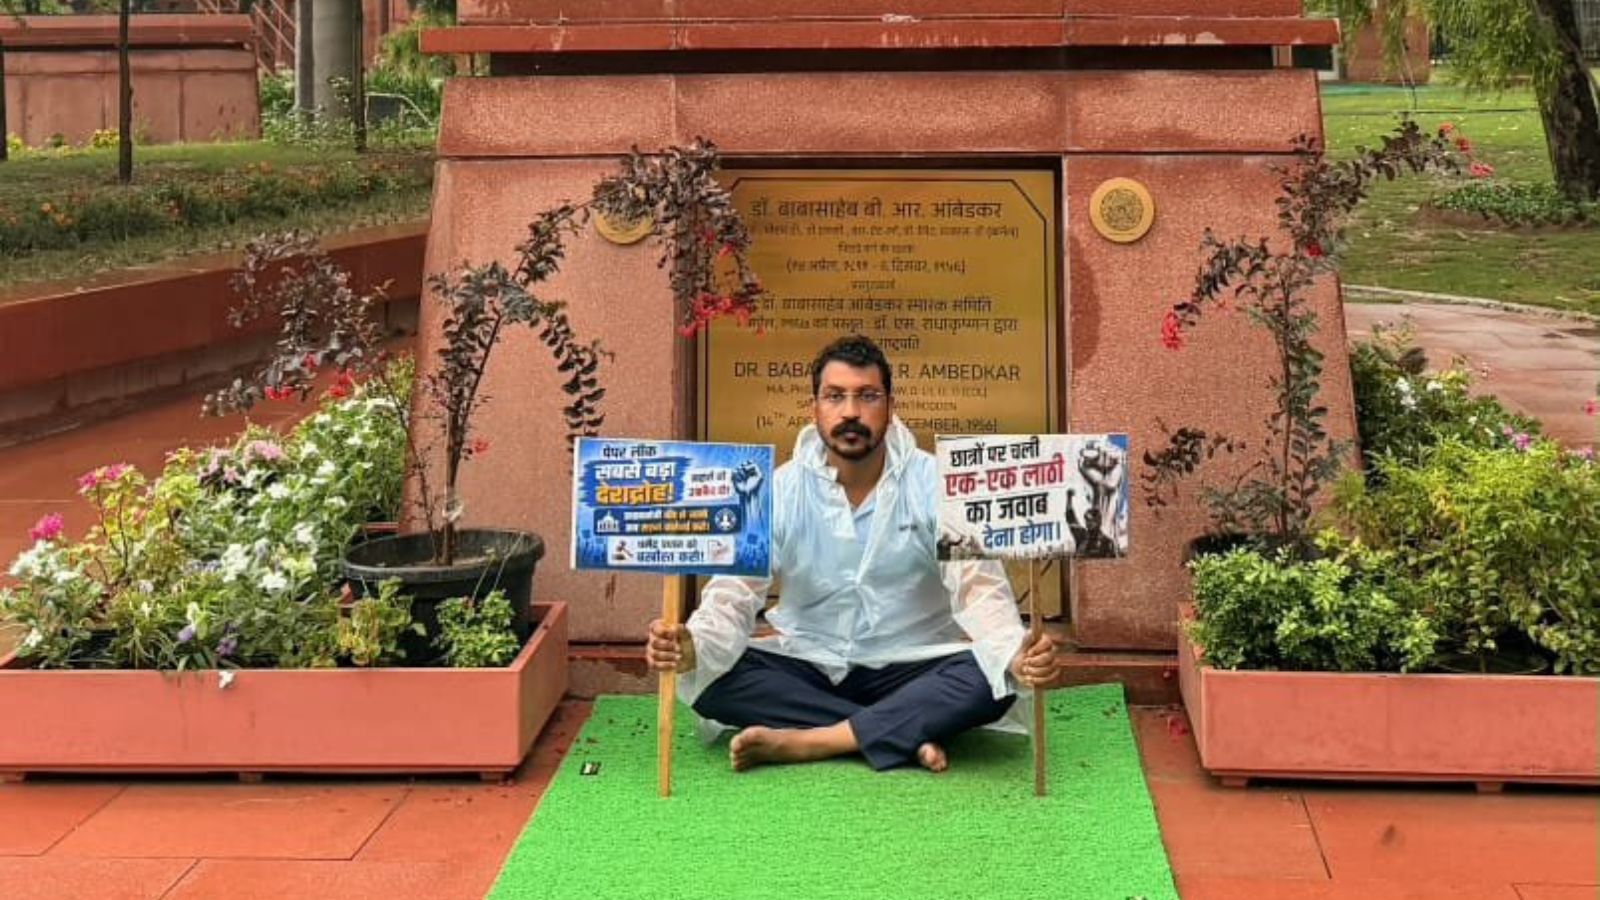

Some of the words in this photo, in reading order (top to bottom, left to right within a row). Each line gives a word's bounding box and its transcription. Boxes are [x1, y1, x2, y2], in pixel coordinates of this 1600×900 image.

[778, 198, 858, 218] बाबासाहेब
[922, 318, 990, 335] राधाकृष्णन
[767, 362, 815, 378] BABA
[920, 363, 1021, 380] AMBEDKAR
[951, 441, 984, 467] छात्रों
[988, 446, 1006, 463] पर
[1010, 436, 1040, 460] चली
[595, 459, 641, 480] सबसे
[645, 462, 675, 482] बड़ा
[944, 467, 1017, 497] एक-एक
[1020, 452, 1066, 487] लाठी
[965, 499, 992, 524] का
[996, 492, 1048, 520] जवाब
[981, 524, 1015, 550] देना
